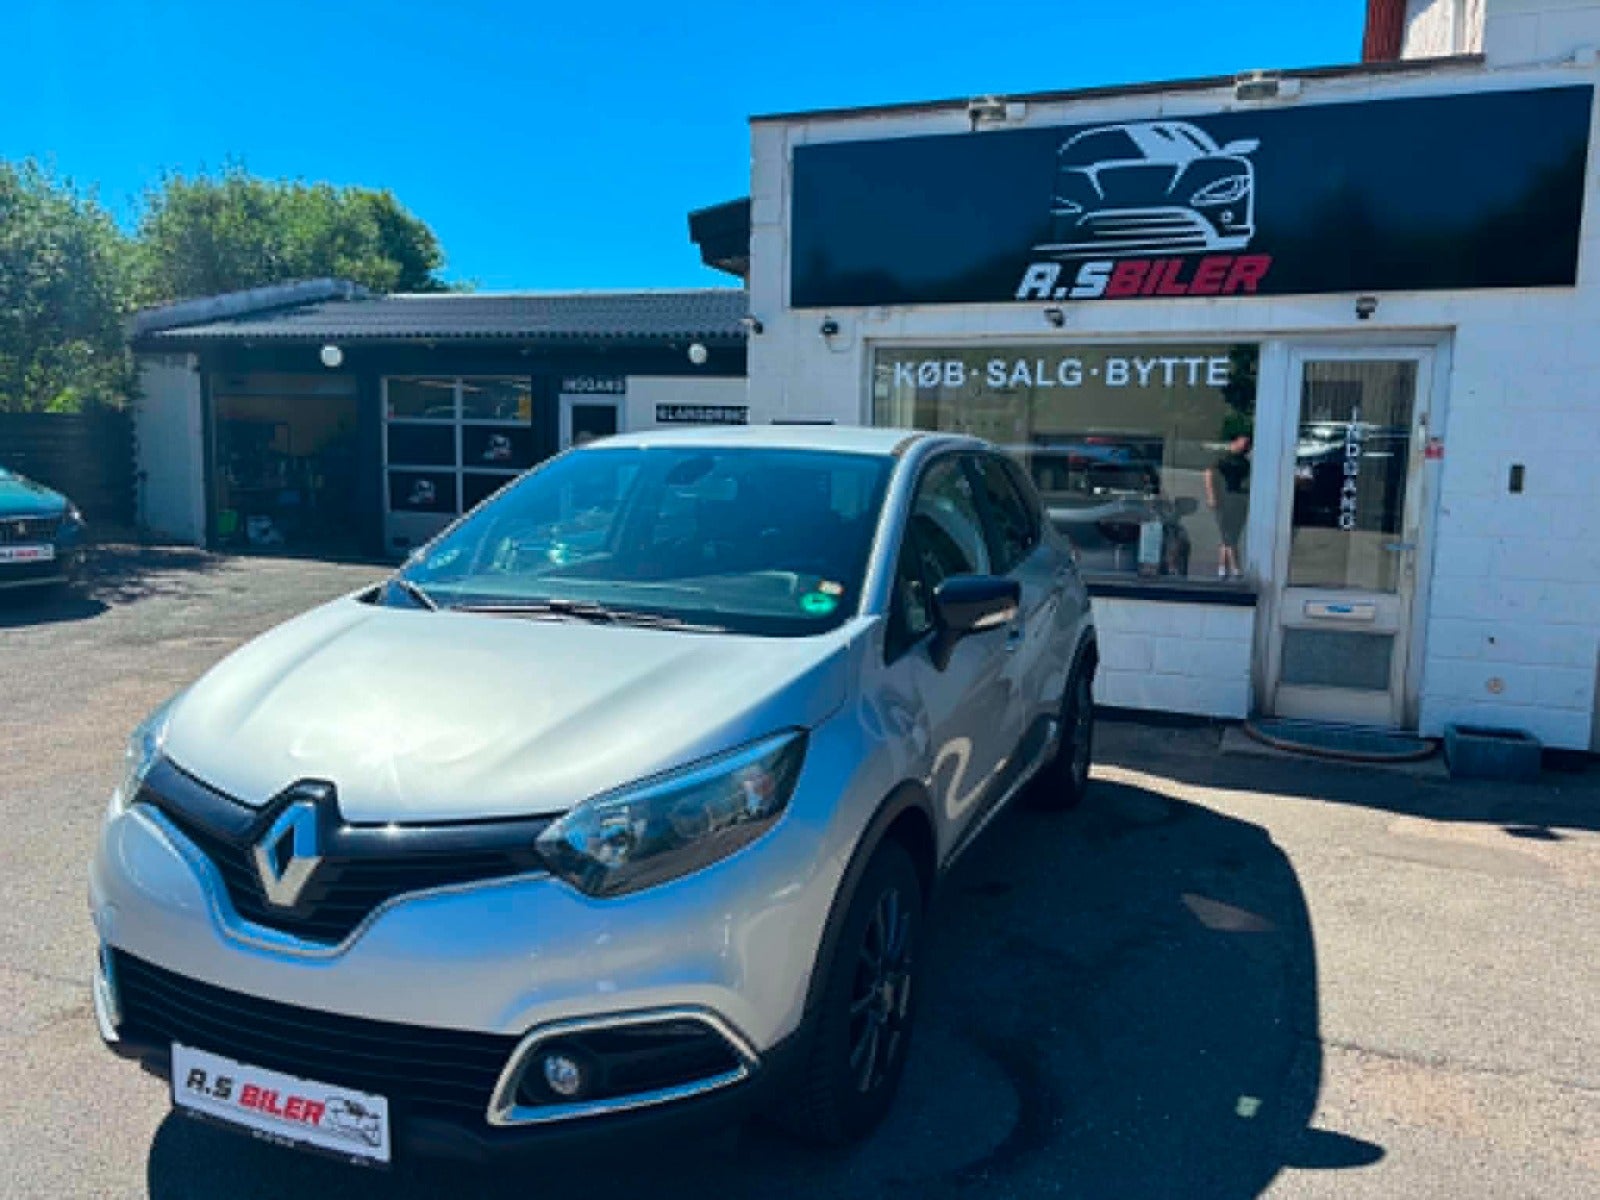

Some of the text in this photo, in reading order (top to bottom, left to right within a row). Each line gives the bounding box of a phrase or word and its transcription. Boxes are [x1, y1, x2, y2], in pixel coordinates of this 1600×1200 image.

[893, 355, 1232, 389] KØB SALG BYTTE
[238, 1082, 327, 1127] BILER
